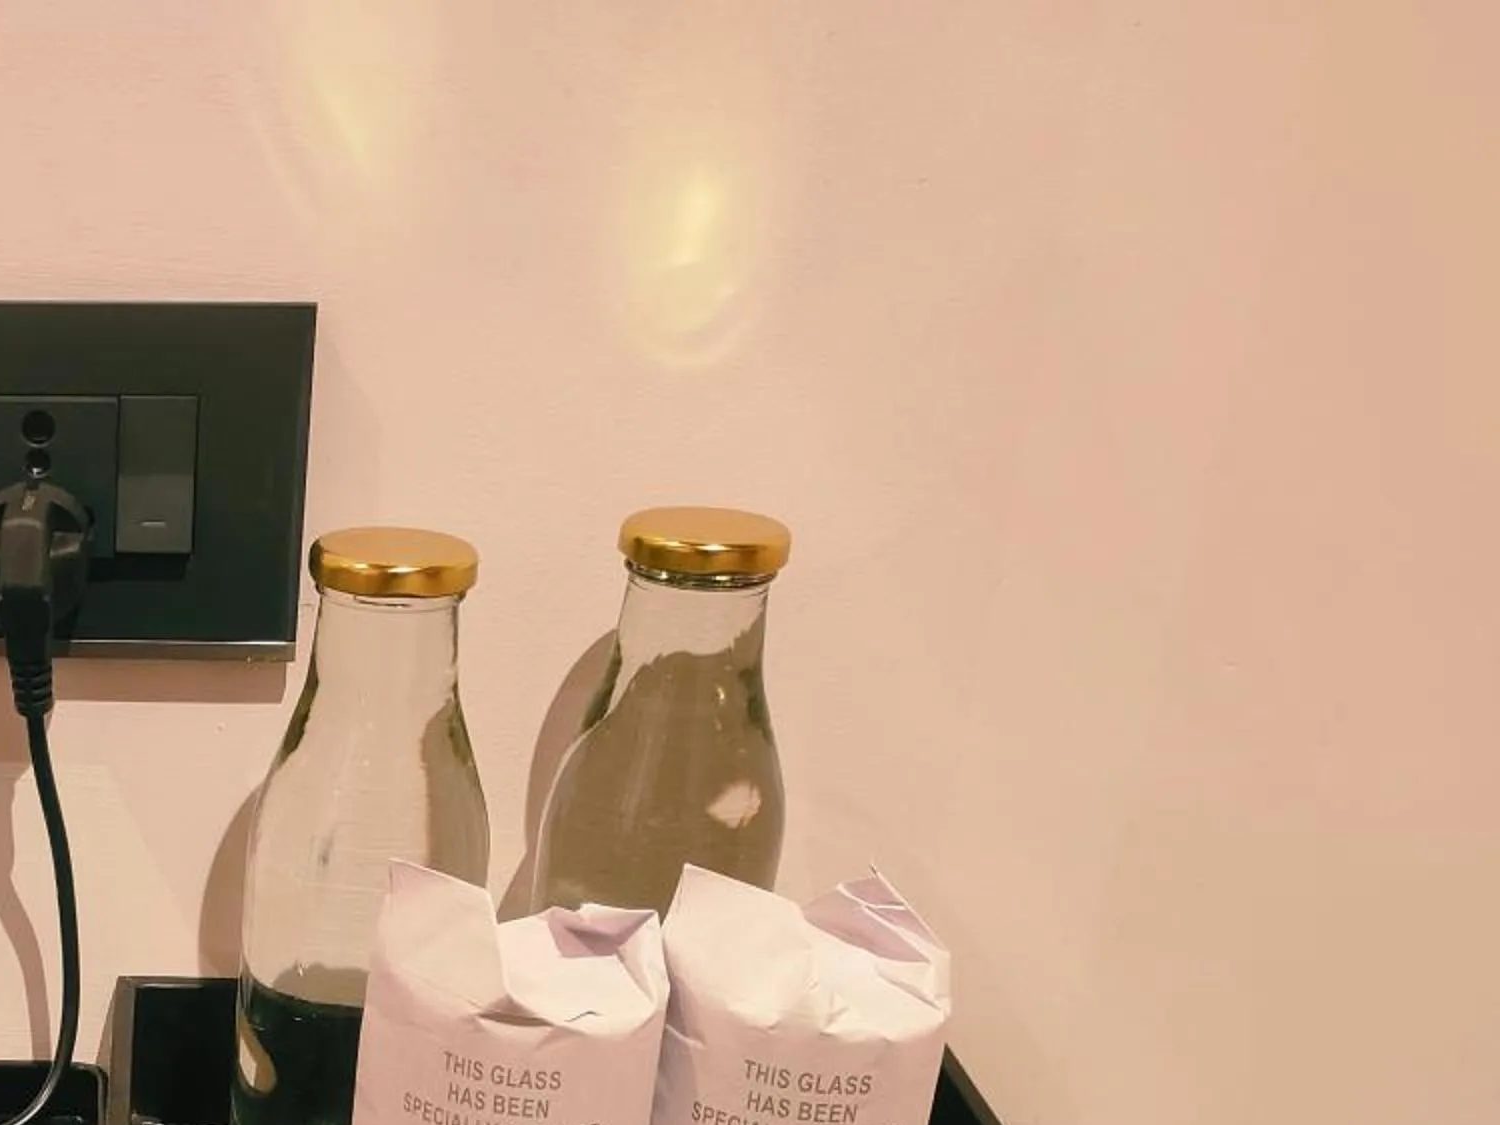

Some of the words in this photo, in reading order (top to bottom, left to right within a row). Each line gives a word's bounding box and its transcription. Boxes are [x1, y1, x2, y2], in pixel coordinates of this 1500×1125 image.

[444, 1051, 485, 1081] THIS
[490, 1065, 562, 1090] GLASS
[744, 1060, 790, 1089] THIS
[797, 1073, 873, 1095] GLASS
[448, 1082, 485, 1111] HAS
[493, 1095, 549, 1118] BEEN
[747, 1091, 790, 1119] HAS
[797, 1102, 858, 1123] BEEN
